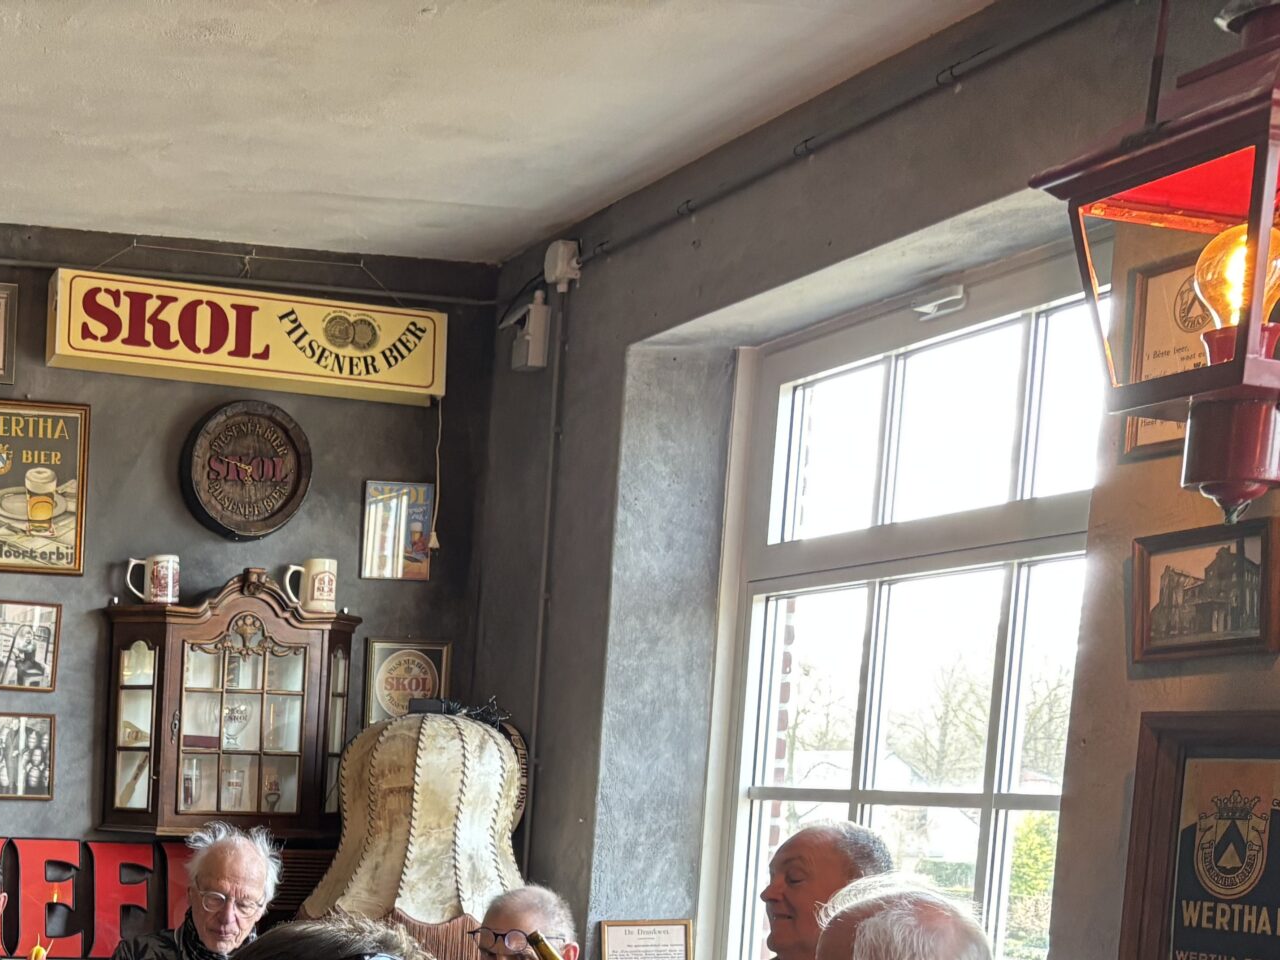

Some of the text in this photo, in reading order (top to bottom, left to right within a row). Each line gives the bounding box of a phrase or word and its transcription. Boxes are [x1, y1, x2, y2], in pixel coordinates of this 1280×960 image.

[81, 287, 270, 360] SKOL
[277, 307, 428, 377] PILSENER BIER
[210, 421, 288, 456] PILSENER BIER
[22, 449, 62, 465] BIER
[208, 455, 288, 481] SKOL
[208, 480, 289, 516] PILSENER BIER
[384, 676, 431, 691] SKOL
[1182, 900, 1272, 936] WERTHA
